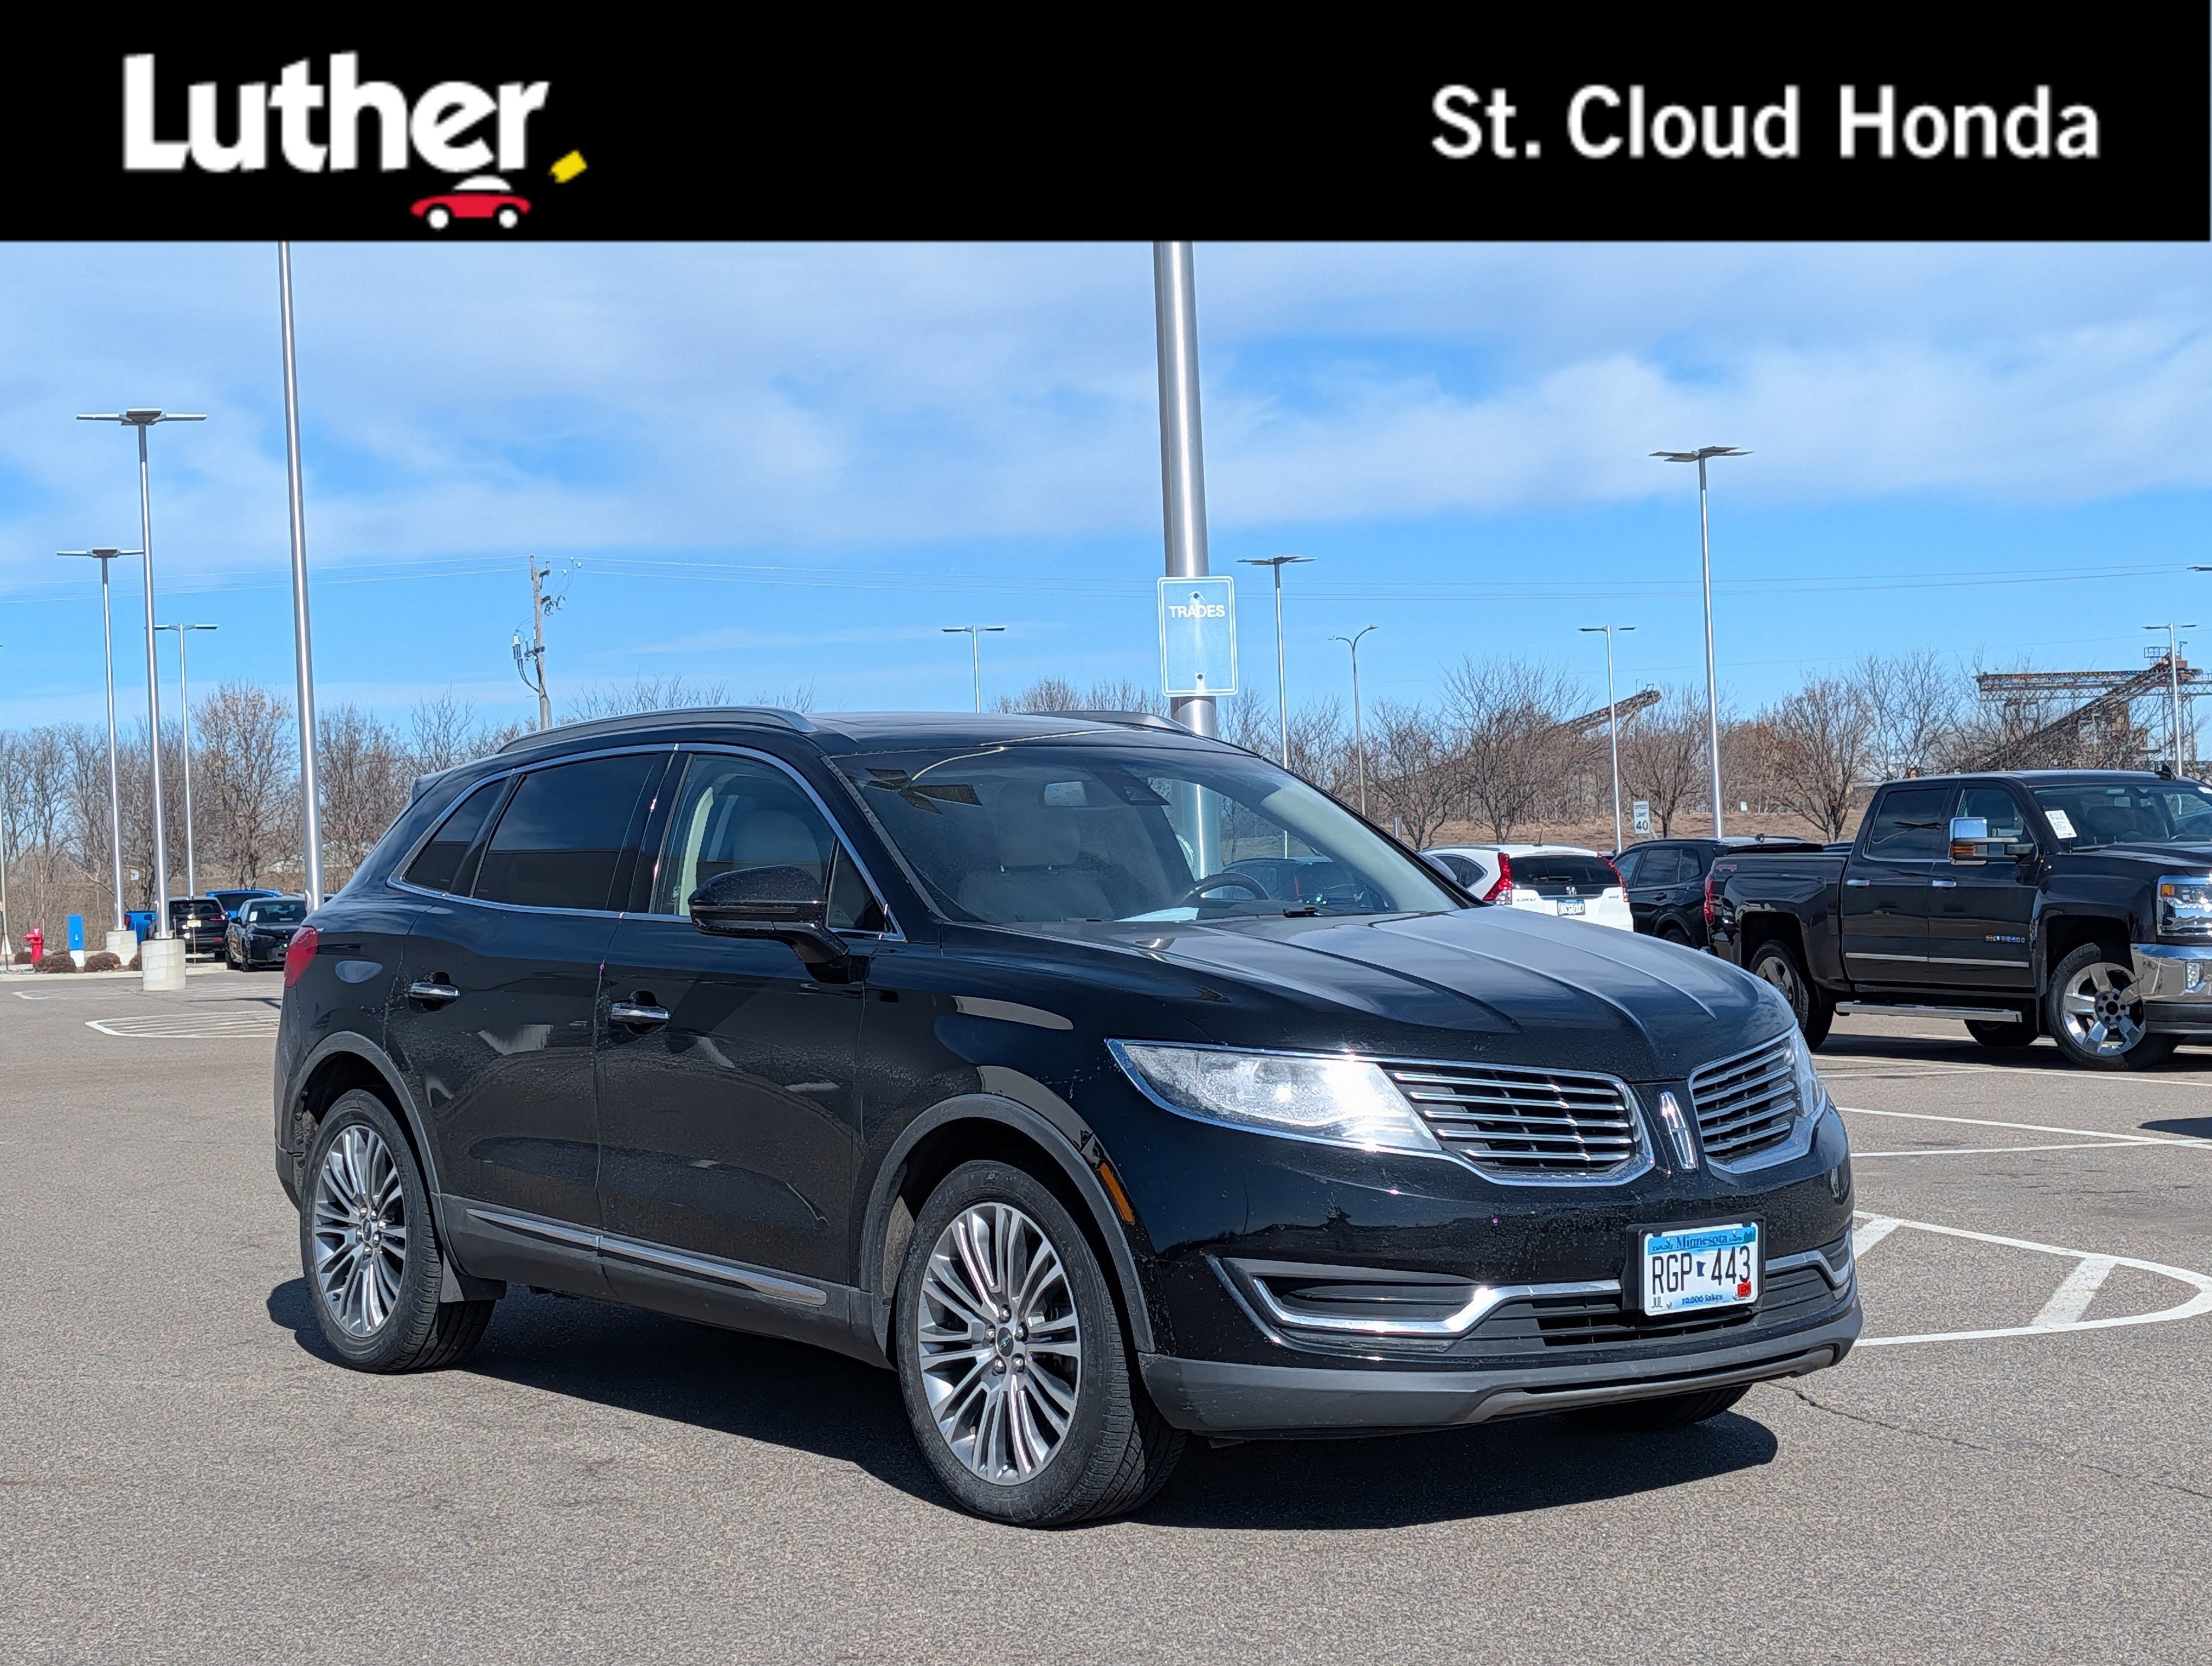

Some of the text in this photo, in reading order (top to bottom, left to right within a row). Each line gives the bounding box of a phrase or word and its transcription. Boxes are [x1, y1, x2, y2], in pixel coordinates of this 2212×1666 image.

[1168, 605, 1225, 618] TRADES
[1636, 820, 1648, 830] 40
[1676, 1234, 1727, 1249] Minnesota
[1652, 1246, 1751, 1295] RGP 443
